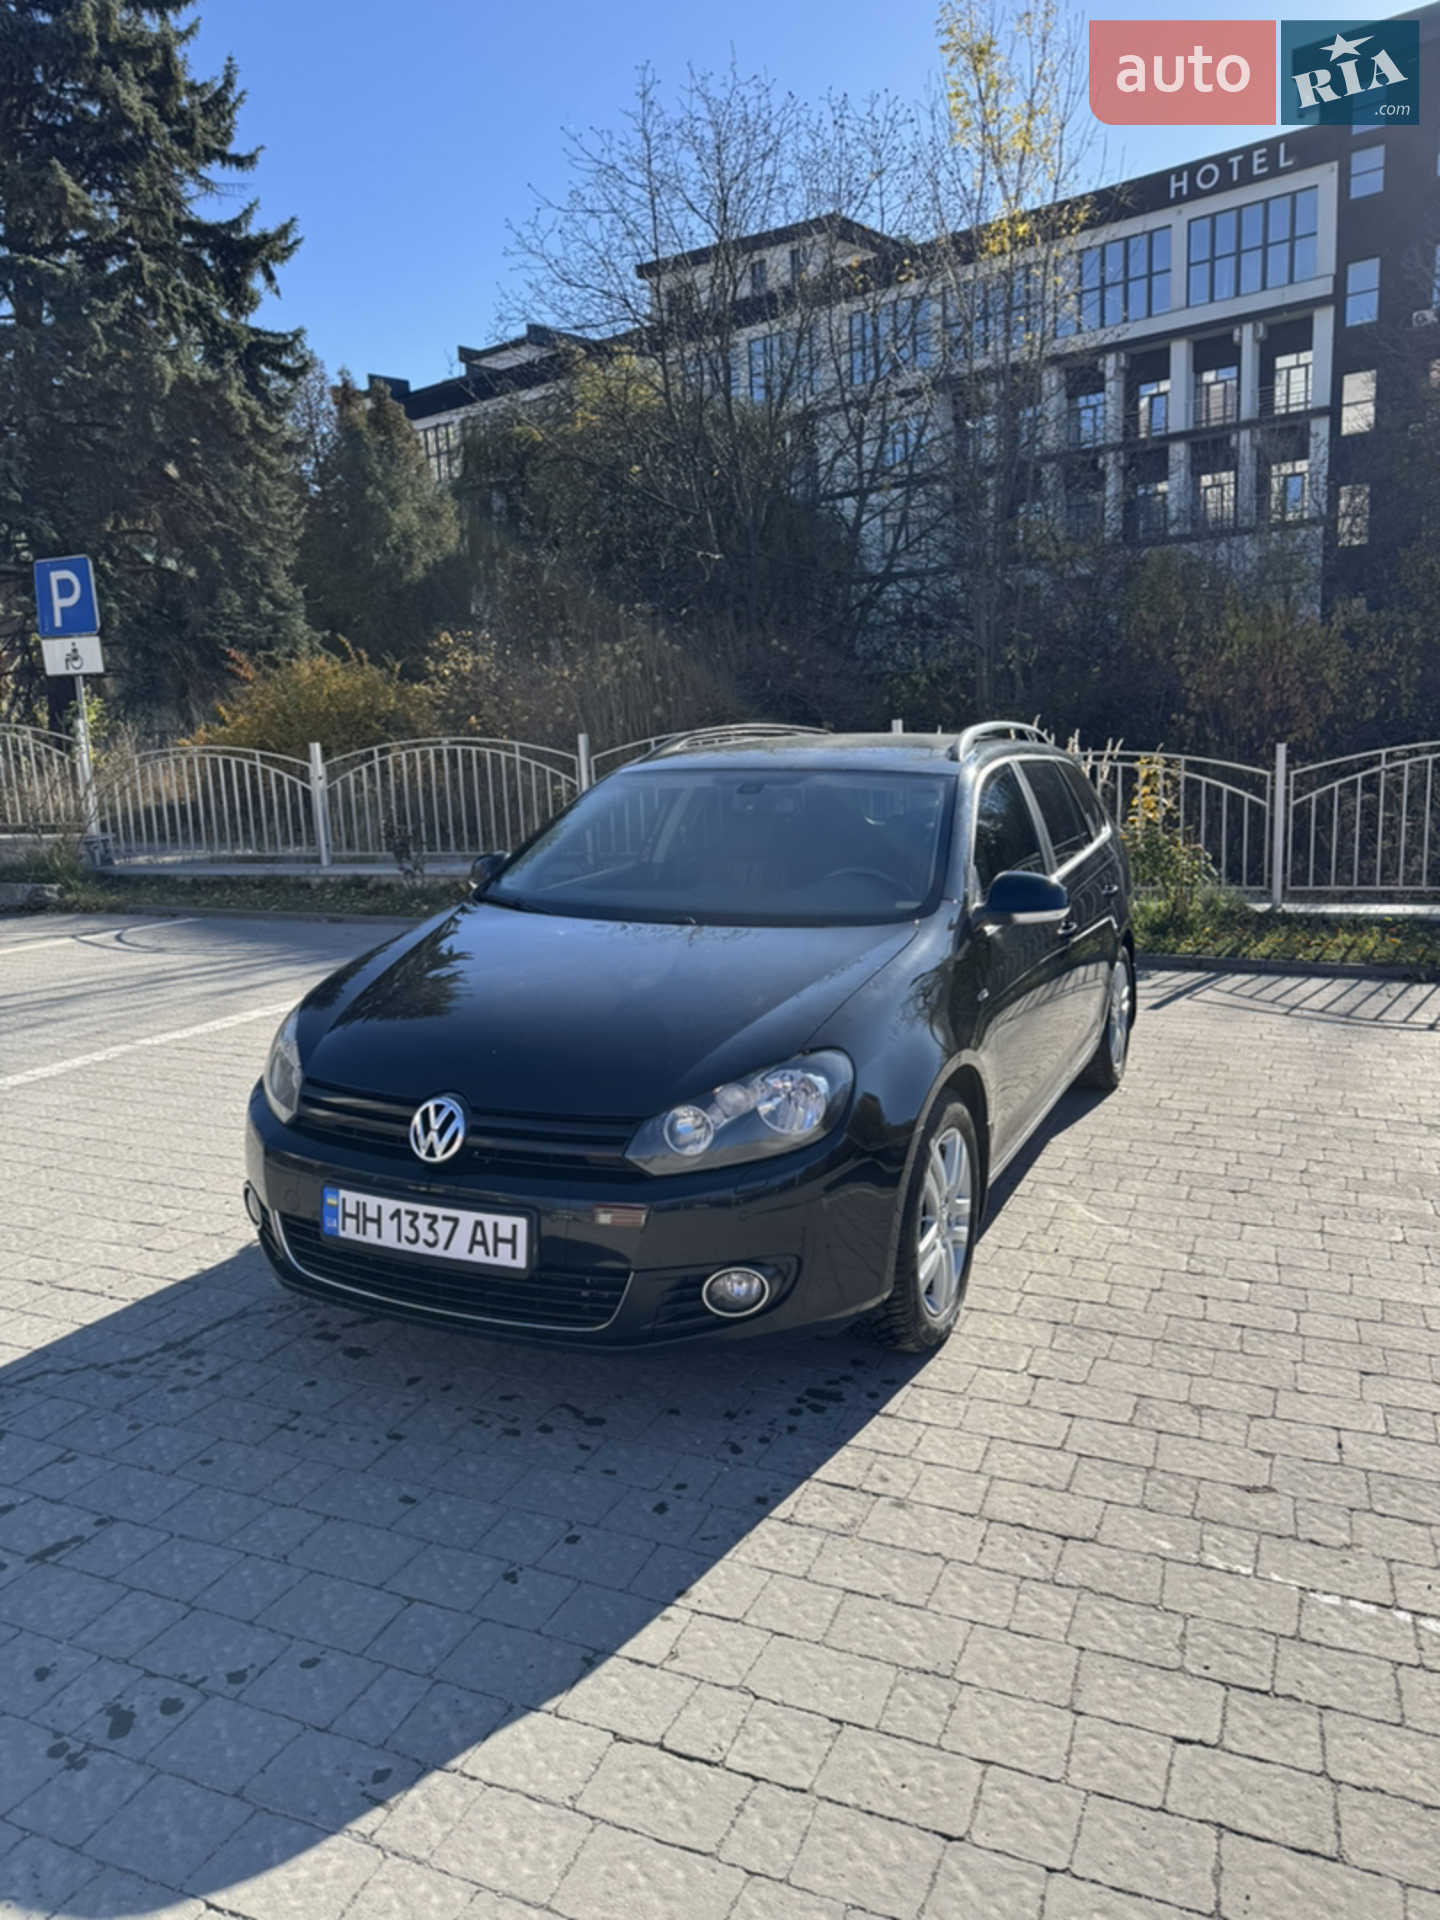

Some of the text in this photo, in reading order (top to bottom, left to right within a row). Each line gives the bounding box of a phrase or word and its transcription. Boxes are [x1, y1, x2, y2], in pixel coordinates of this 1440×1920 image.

[1169, 142, 1298, 200] HOTEL
[50, 569, 82, 628] P
[410, 1096, 465, 1163] VW
[341, 1197, 518, 1260] HH 1337 AH
